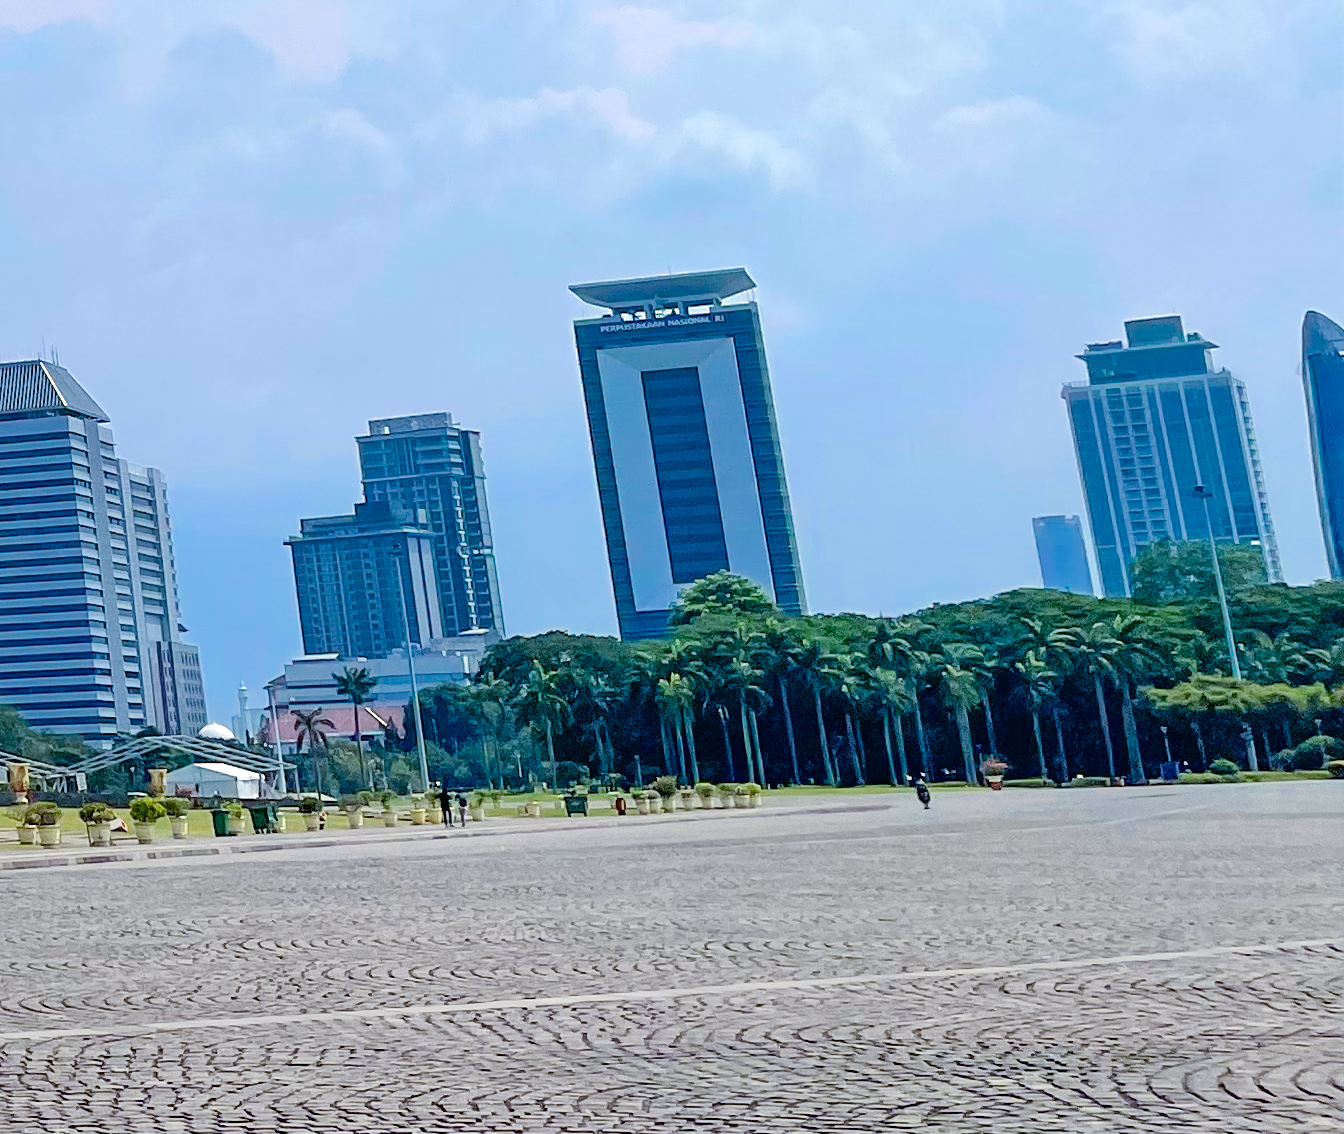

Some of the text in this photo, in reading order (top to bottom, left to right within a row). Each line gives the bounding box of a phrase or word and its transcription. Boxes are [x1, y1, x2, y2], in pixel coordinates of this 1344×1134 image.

[599, 314, 725, 333] PERPUSTAKAAN NASIONAL RI
